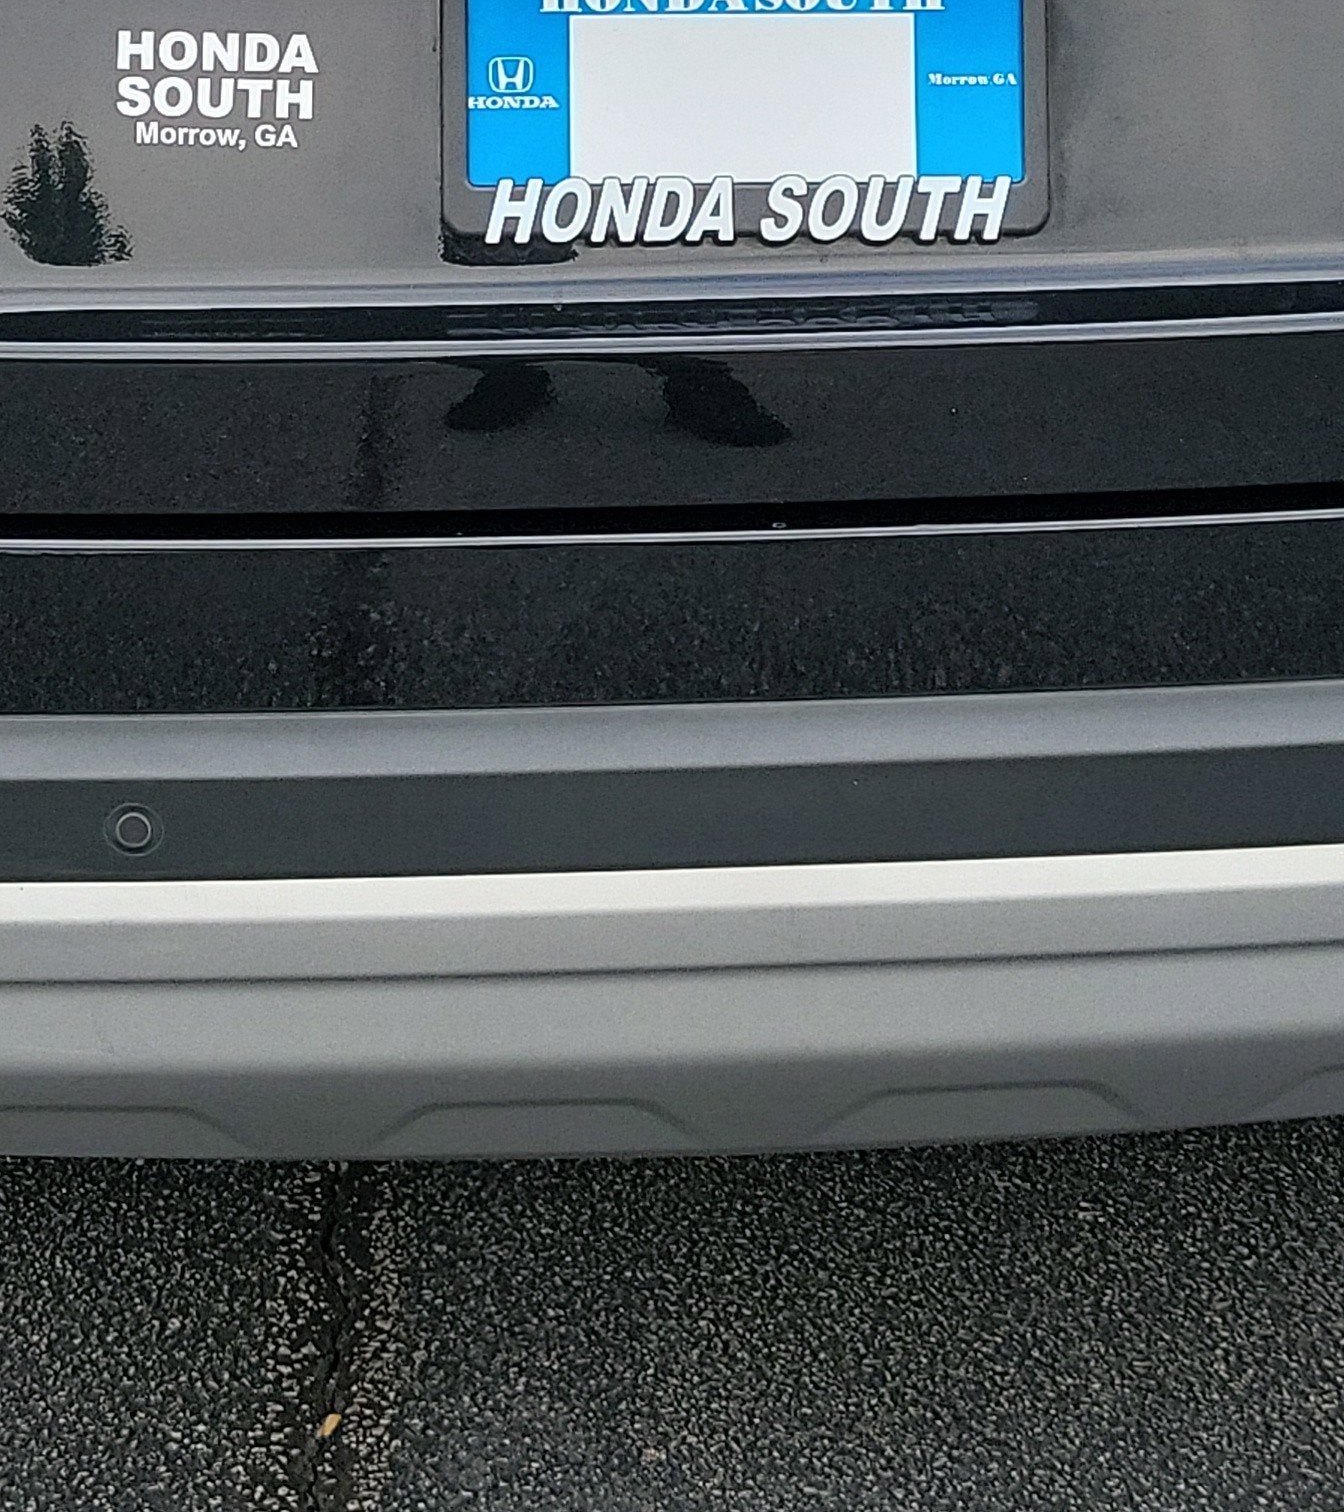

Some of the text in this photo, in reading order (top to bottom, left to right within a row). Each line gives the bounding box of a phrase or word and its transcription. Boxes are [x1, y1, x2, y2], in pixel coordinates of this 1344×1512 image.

[116, 30, 320, 74] HONDA
[992, 72, 1018, 86] GA
[116, 76, 314, 120] SOUTH
[468, 96, 560, 110] HONDA
[135, 121, 299, 151] Morrow, GA
[484, 175, 1013, 243] HONDA SOUTH
